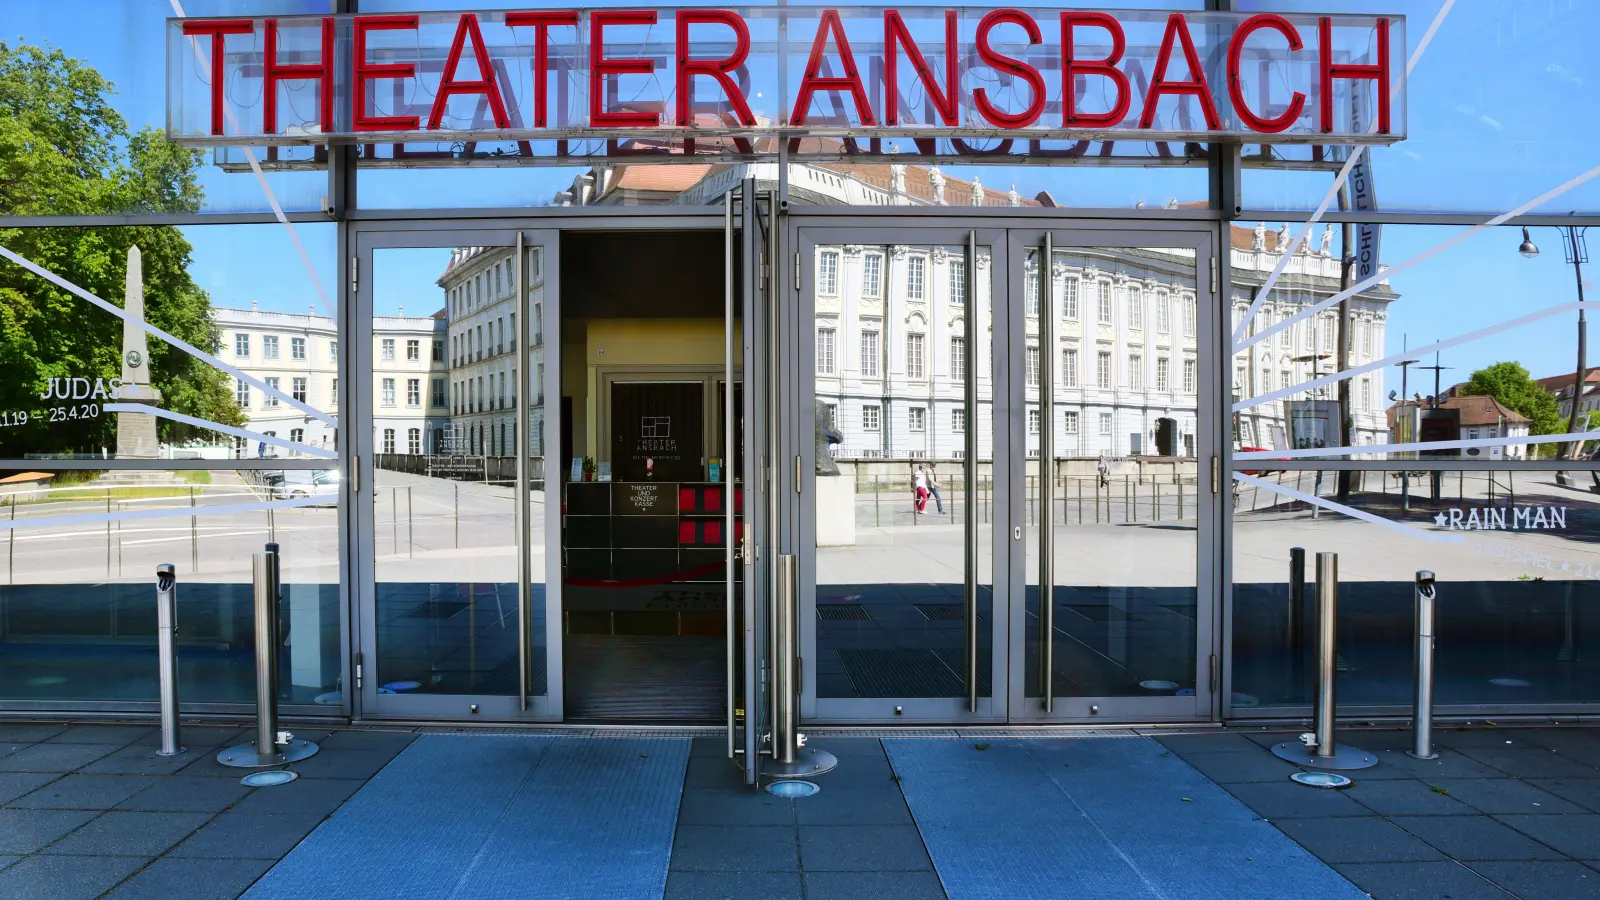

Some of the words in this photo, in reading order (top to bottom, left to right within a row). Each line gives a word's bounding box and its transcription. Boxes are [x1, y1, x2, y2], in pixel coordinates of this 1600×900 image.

[182, 9, 757, 135] THEATER
[790, 8, 1390, 134] ANSBACH
[40, 377, 123, 400] JUDAS
[49, 403, 99, 423] 25.4.20
[1448, 507, 1507, 530] RAIN
[1512, 506, 1567, 529] MAN
[1471, 542, 1554, 570] GASTSPIEL
